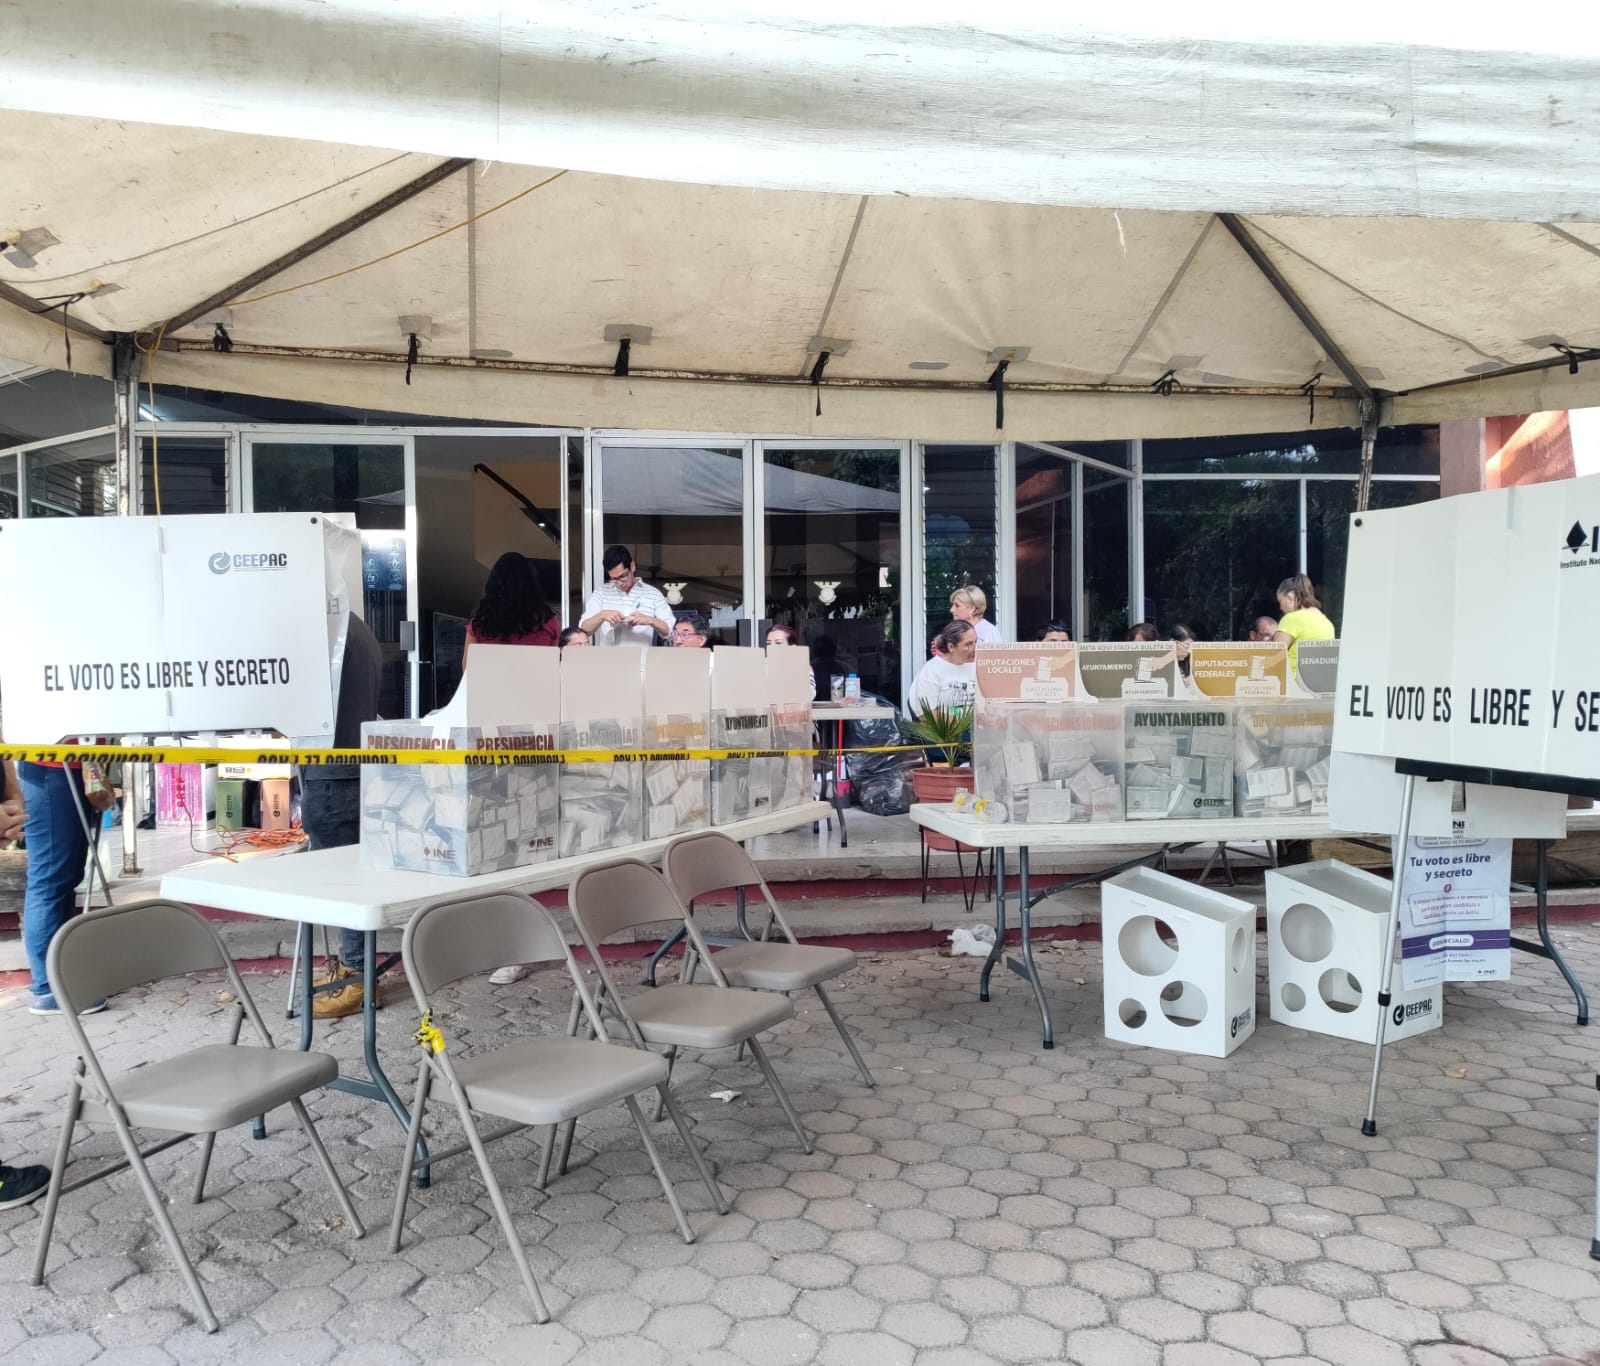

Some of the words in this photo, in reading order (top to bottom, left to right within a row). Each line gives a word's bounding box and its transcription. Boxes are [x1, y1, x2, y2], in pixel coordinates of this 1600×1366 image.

[233, 553, 287, 567] CEEPAC
[1560, 559, 1588, 569] Instituto
[977, 658, 1036, 666] DIPUTACIONES
[1081, 663, 1133, 671] AYUNTAMIENTO
[1194, 659, 1249, 667] DIPUTACIONES
[44, 664, 64, 692] EL
[69, 663, 114, 690] VOTO
[120, 662, 140, 689] ES
[146, 661, 193, 688] LIBRE
[199, 660, 209, 687] Y
[215, 657, 290, 686] SECRETO
[987, 666, 1023, 674] LOCALES
[1350, 684, 1374, 717] EL
[1386, 685, 1425, 722] VOTO
[1433, 686, 1452, 723] ES
[1470, 687, 1531, 727] LIBRE
[1551, 689, 1565, 729] Y
[1134, 712, 1226, 727] AYUNTAMIENTO
[367, 735, 457, 750] PRESIDENCIA
[476, 734, 555, 751] PRESIDENCIA
[536, 836, 554, 848] INE
[433, 849, 456, 860] INE
[1410, 857, 1423, 867] Tu
[1425, 856, 1450, 866] voto
[1452, 857, 1463, 865] es
[1465, 853, 1491, 863] libre
[1425, 871, 1432, 882] y
[1433, 868, 1473, 879] secreto
[1405, 998, 1433, 1017] CEEPAC
